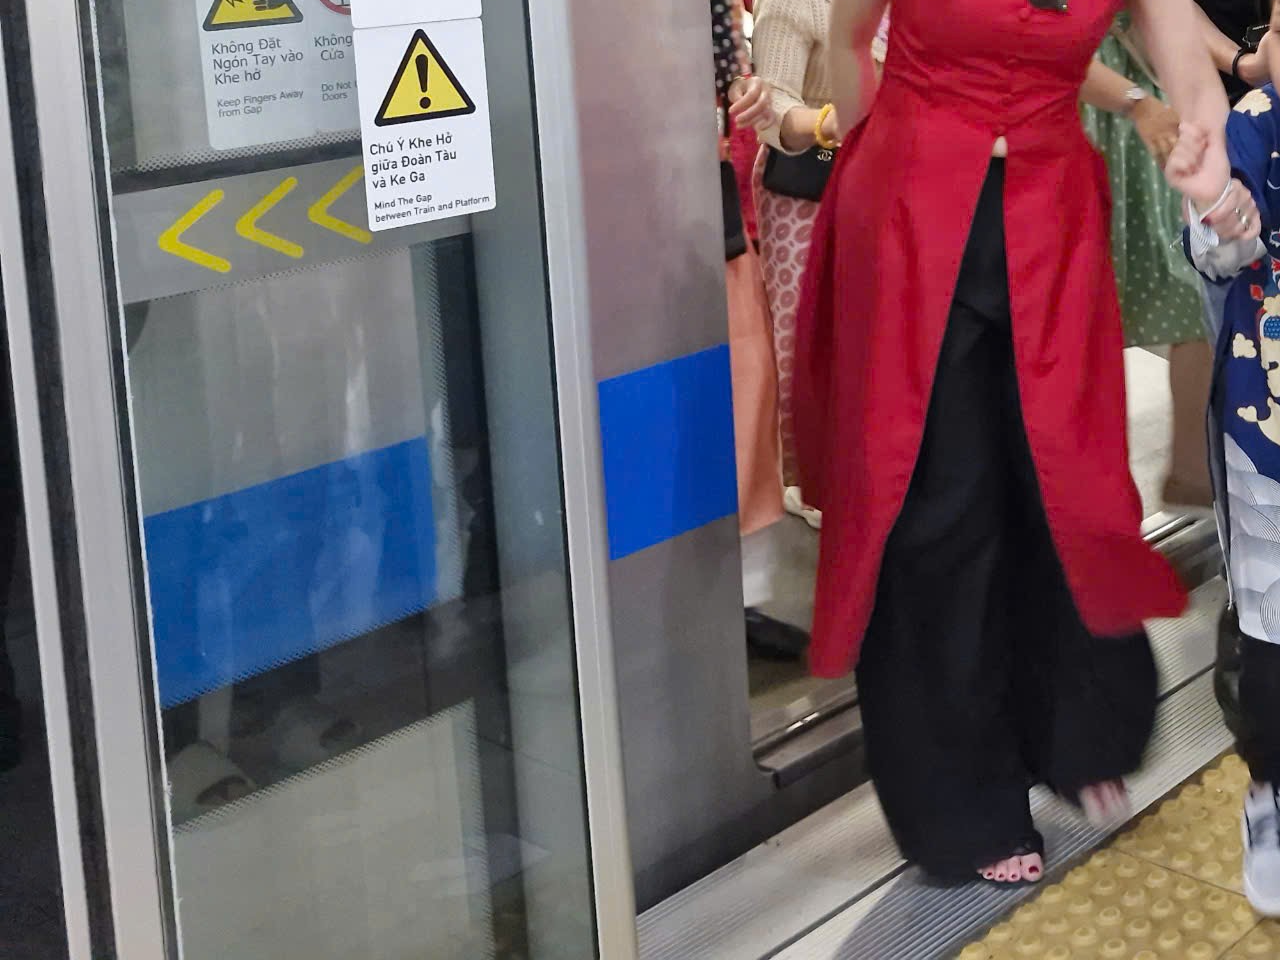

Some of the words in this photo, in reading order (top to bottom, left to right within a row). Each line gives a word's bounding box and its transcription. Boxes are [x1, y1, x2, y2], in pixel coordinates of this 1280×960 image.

[211, 40, 253, 55] Không
[259, 37, 282, 51] Đặt
[314, 33, 353, 48] Không
[213, 55, 248, 72] Ngón
[253, 53, 276, 67] Tay
[281, 49, 304, 62] vào
[214, 72, 240, 85] Khe
[244, 68, 261, 82] hở
[321, 83, 334, 92] Do
[336, 80, 352, 90] Not
[217, 96, 241, 108] Keep
[243, 93, 277, 105] Fingers
[279, 90, 304, 100] Away
[322, 91, 348, 102] Doors
[218, 108, 241, 118] from
[243, 105, 263, 115] Gap
[369, 141, 394, 155] Chú
[396, 137, 405, 151] Ý
[409, 137, 432, 150] Khe
[436, 131, 453, 145] Hở
[371, 159, 398, 175] giữa
[401, 154, 432, 168] Đoàn
[435, 150, 457, 162] Tàu
[372, 176, 387, 189] và
[390, 174, 406, 187] Ke
[409, 171, 426, 183] Ga
[374, 199, 396, 210] Mind
[398, 196, 414, 206] The
[416, 194, 432, 205] Gap
[375, 209, 412, 223] between
[414, 205, 436, 215] Train
[438, 201, 453, 211] and
[455, 196, 490, 208] Platform
